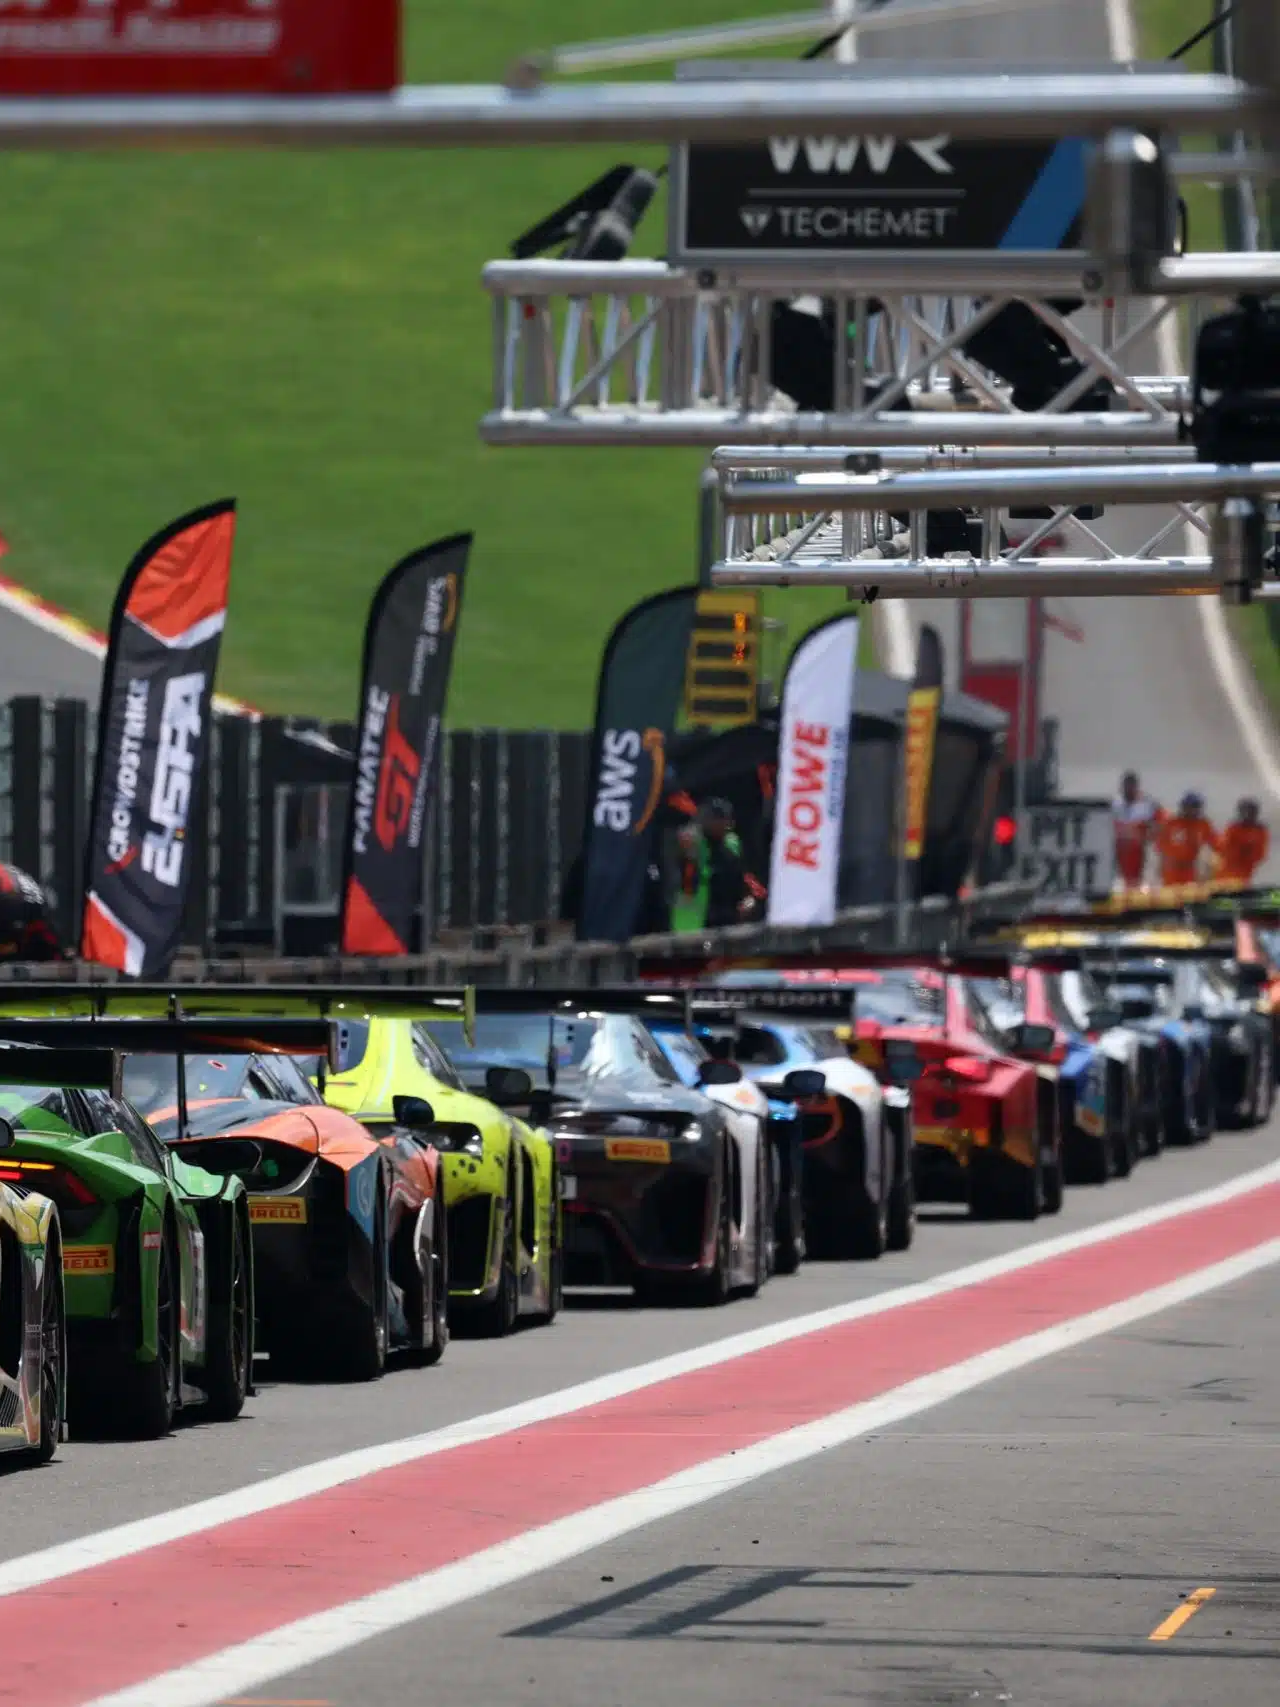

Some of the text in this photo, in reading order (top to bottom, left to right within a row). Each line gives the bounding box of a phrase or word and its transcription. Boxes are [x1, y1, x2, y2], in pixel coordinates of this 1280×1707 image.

[352, 684, 391, 854] FANATEC
[593, 728, 642, 833] aws
[784, 721, 832, 871] ROWE
